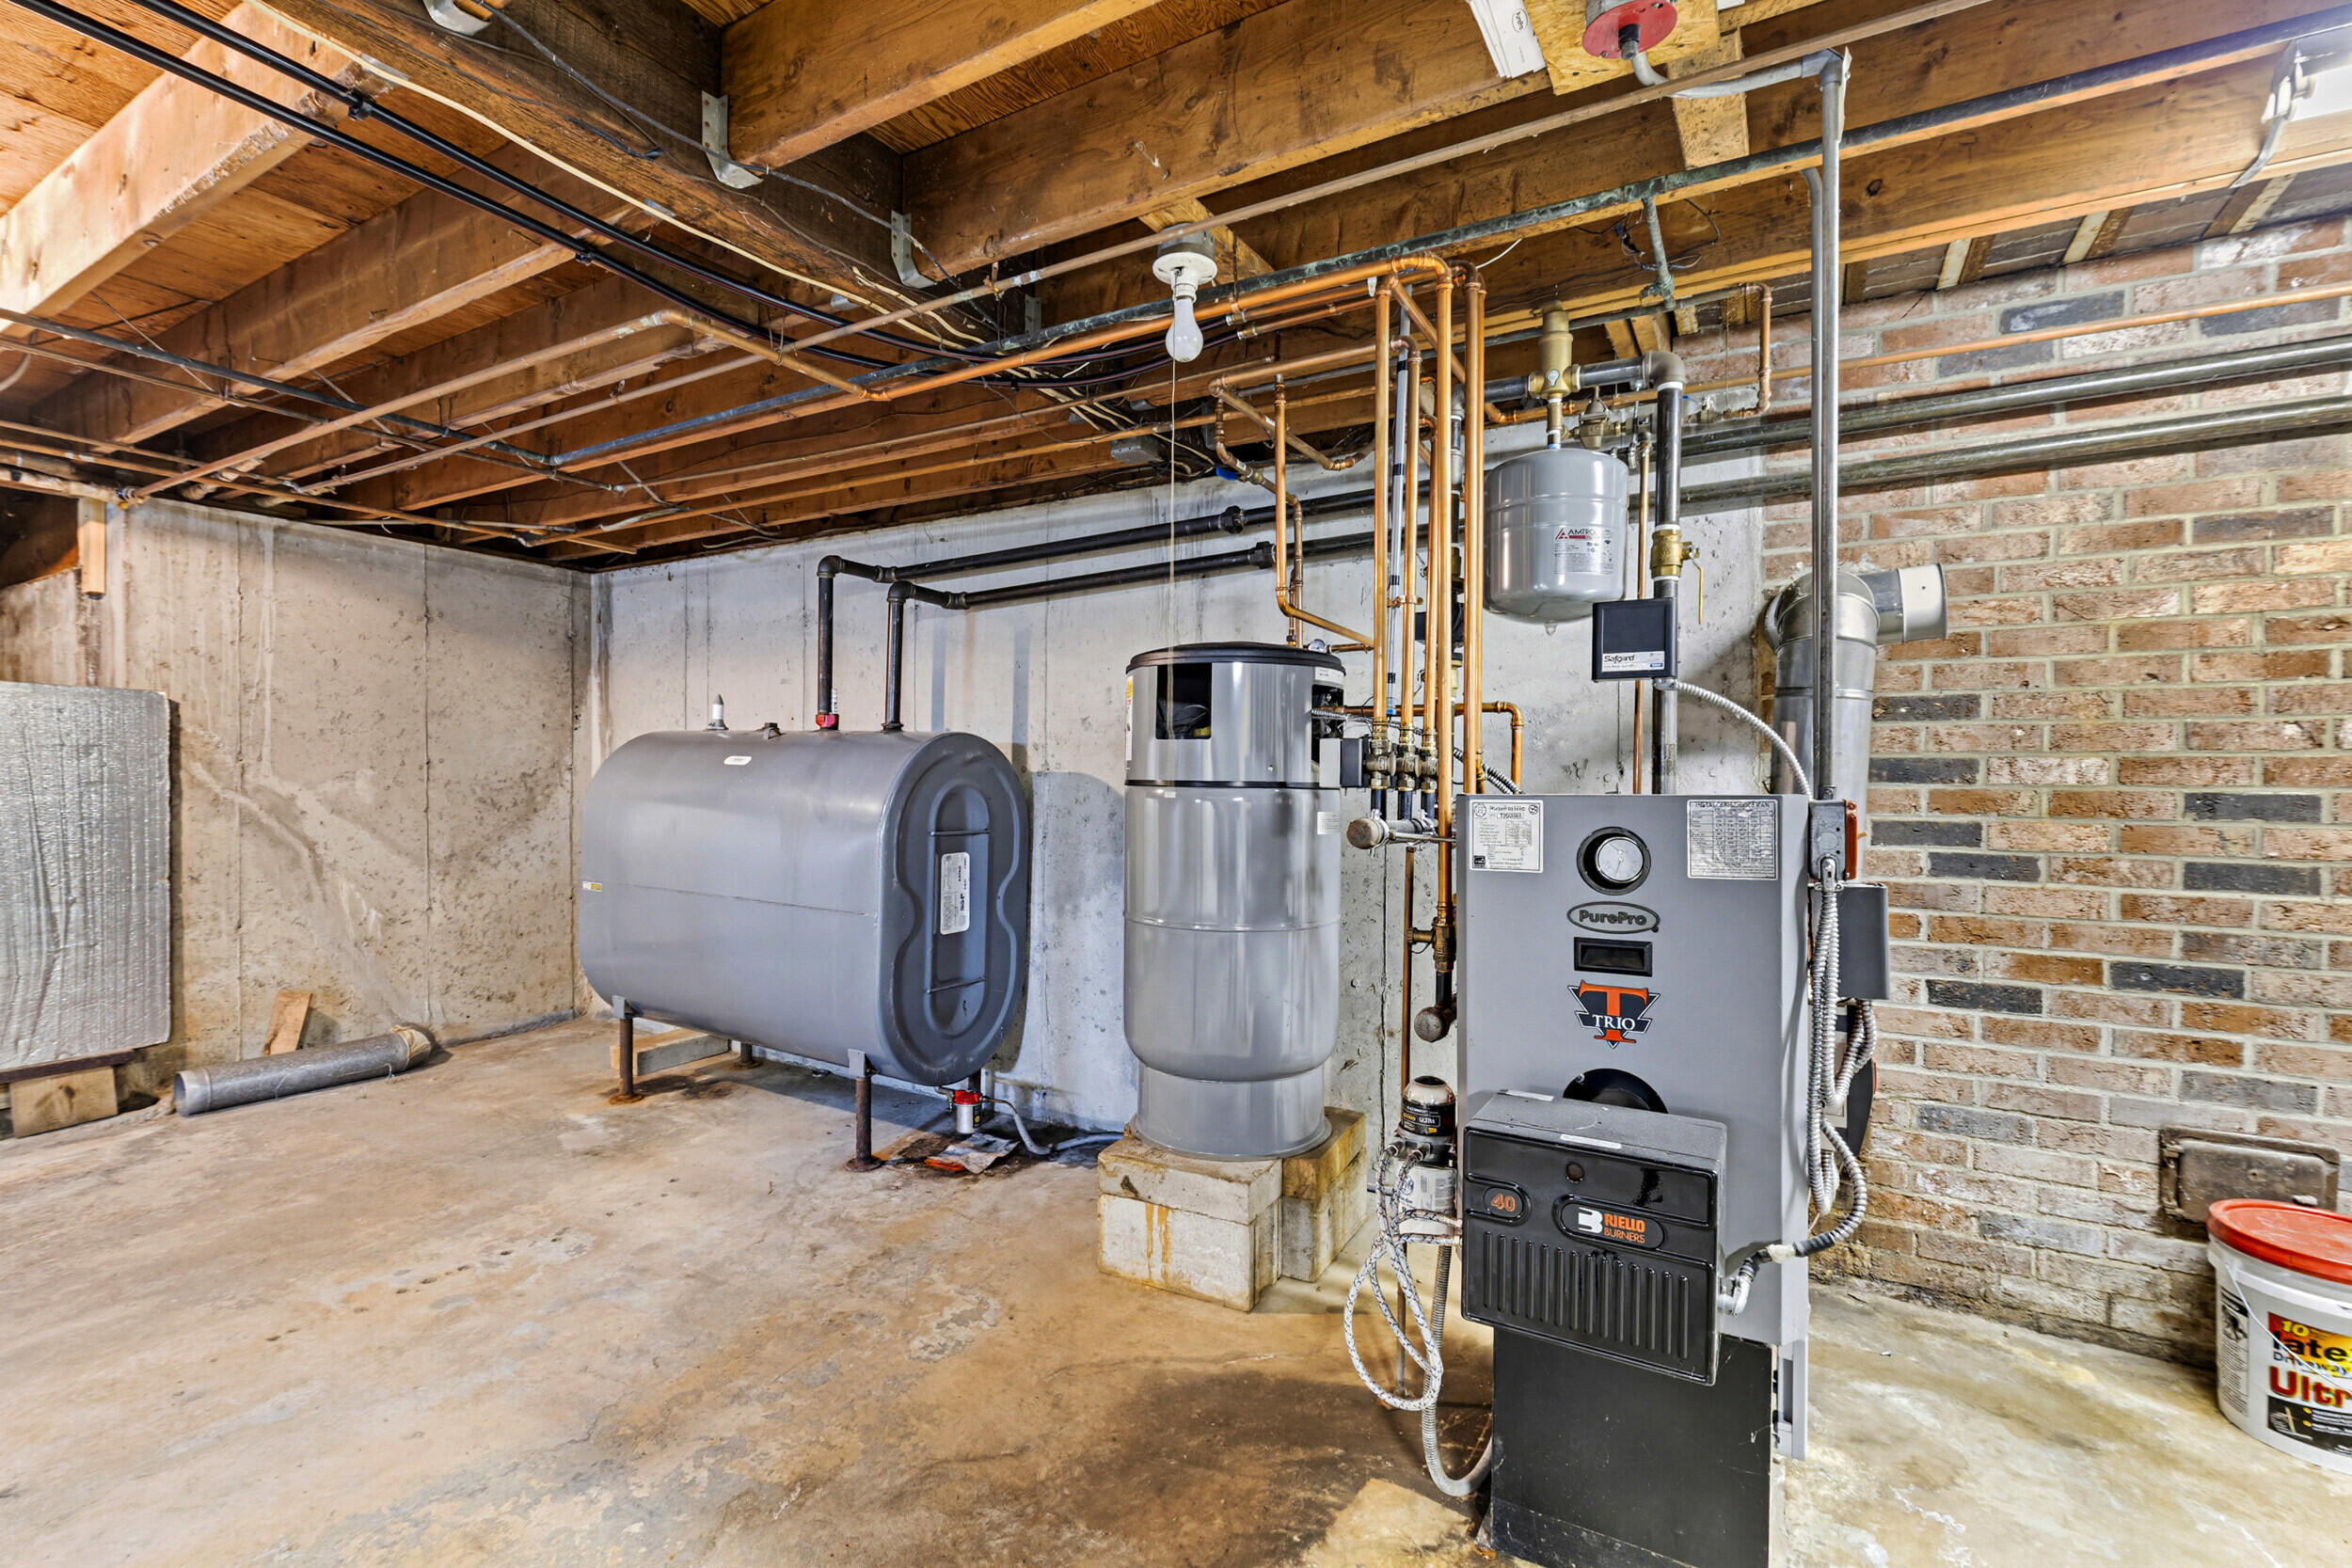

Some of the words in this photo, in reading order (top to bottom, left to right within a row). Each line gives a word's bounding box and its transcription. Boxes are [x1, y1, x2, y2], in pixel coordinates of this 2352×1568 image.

[1567, 528, 1597, 536] AMTRO
[1579, 910, 1647, 926] PurePro
[1592, 1014, 1636, 1031] TRIO
[1491, 1194, 1516, 1212] 40
[1604, 1213, 1645, 1233] RIELLO
[1604, 1227, 1645, 1243] BURNERS
[2280, 1321, 2310, 1338] 10
[2273, 1330, 2352, 1362] late
